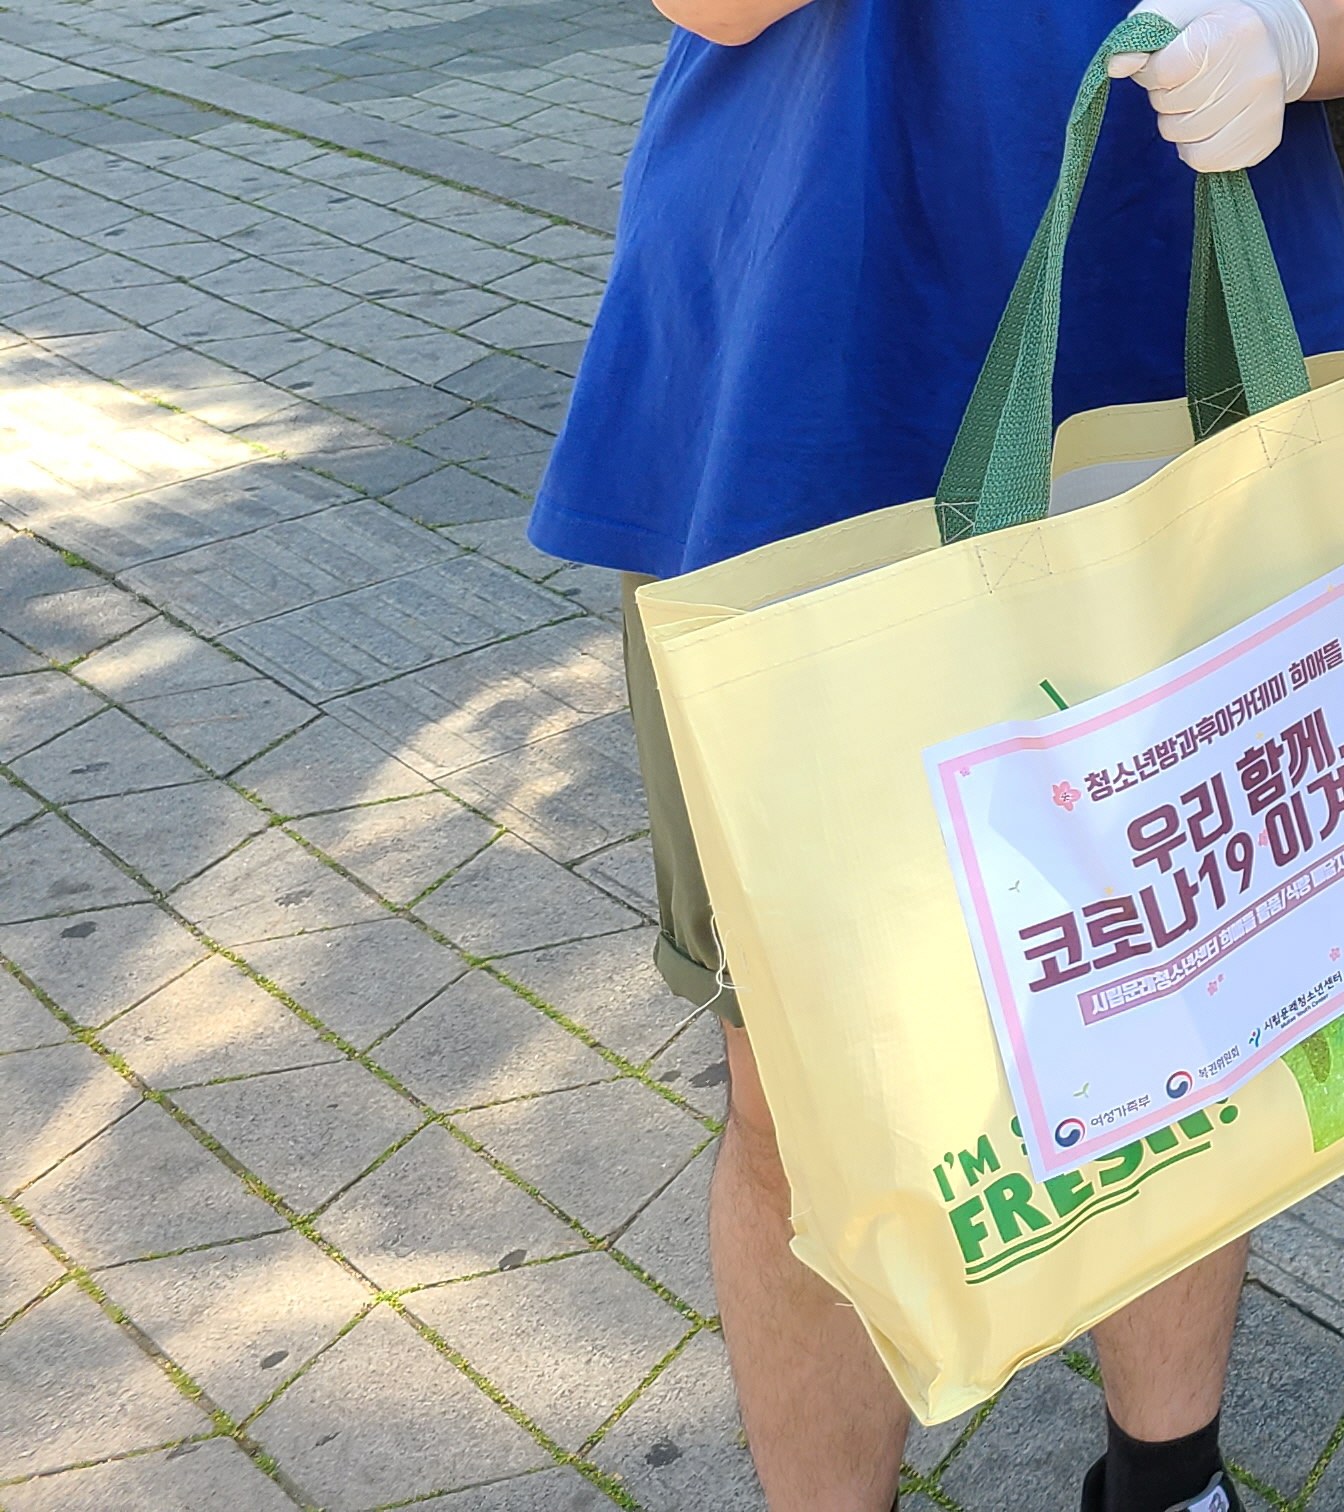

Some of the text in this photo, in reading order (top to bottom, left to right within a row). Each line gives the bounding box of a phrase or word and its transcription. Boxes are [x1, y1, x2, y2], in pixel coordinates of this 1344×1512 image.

[1084, 671, 1288, 802] 청소년방과후아카데미
[1127, 772, 1233, 874] 우리
[1017, 831, 1255, 992] 코로나19
[1264, 971, 1343, 1031] 시립문래청소년센터
[1198, 1045, 1240, 1079] 복권위원회
[1090, 1094, 1151, 1127] 여성가족부
[932, 1133, 1001, 1203] I'M
